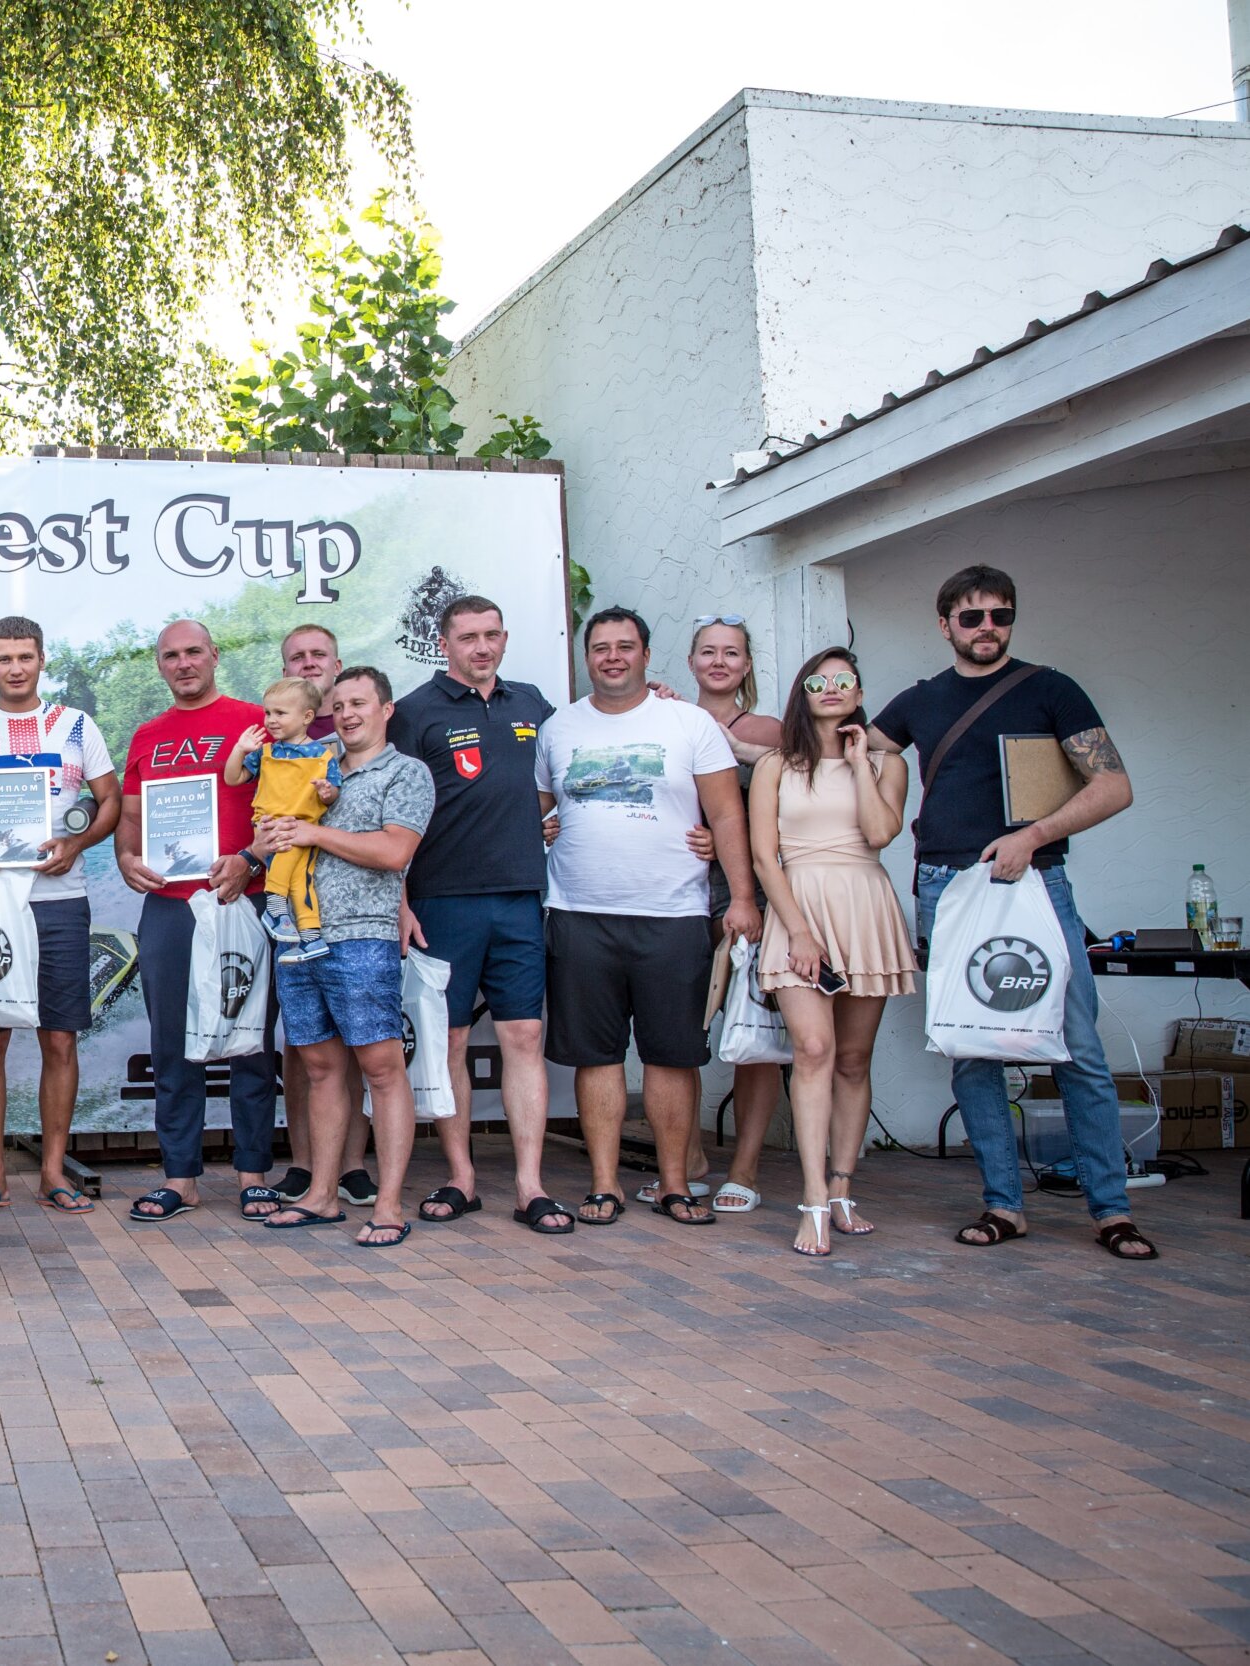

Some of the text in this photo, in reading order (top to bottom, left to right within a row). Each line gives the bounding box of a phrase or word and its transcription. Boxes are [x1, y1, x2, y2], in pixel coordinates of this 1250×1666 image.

[154, 493, 362, 604] Cup
[151, 737, 226, 768] EA7
[156, 793, 205, 805] ДИПЛОМ
[999, 976, 1047, 990] BRP
